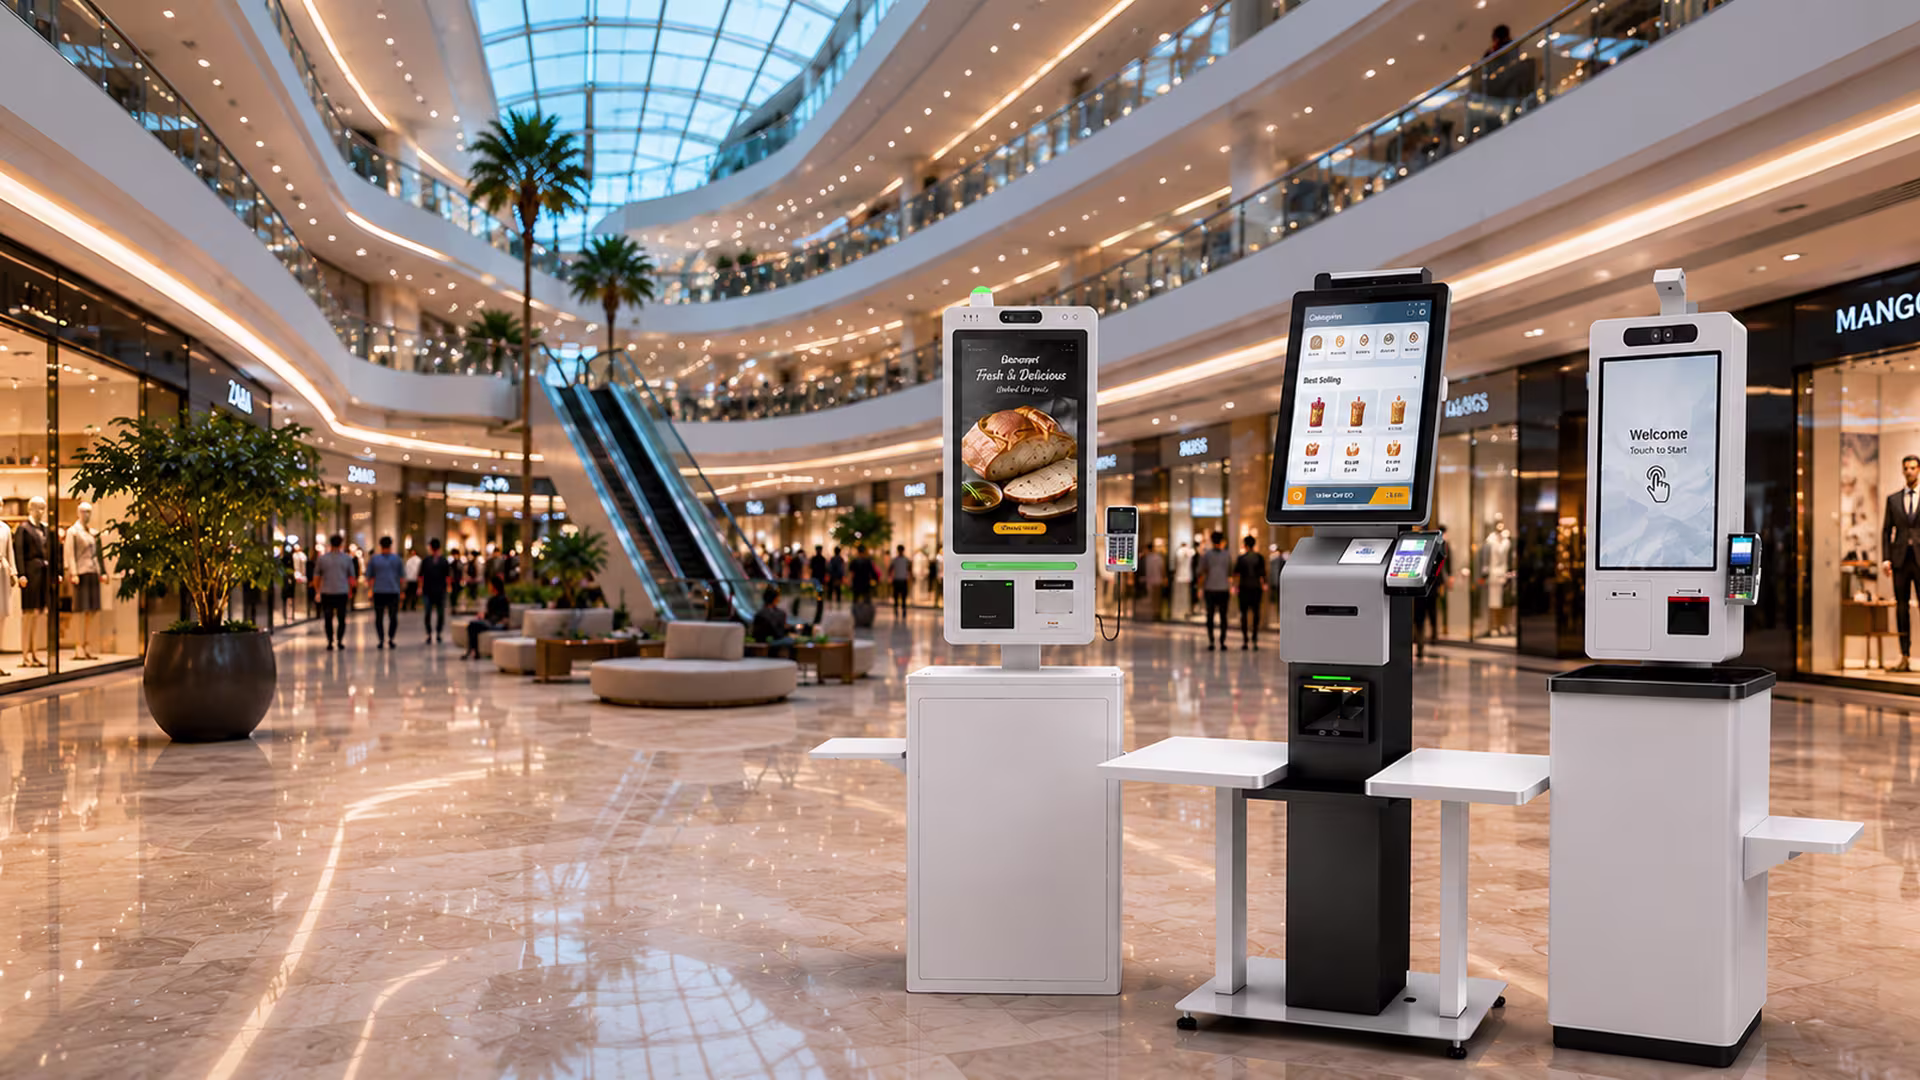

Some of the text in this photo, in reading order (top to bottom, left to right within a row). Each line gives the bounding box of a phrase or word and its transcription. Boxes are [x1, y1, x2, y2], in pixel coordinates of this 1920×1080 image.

[1836, 291, 1920, 334] MANG
[976, 368, 1067, 381] Fresh & Delicious
[1630, 428, 1688, 440] Welcome
[1630, 445, 1688, 455] Touch to Start
